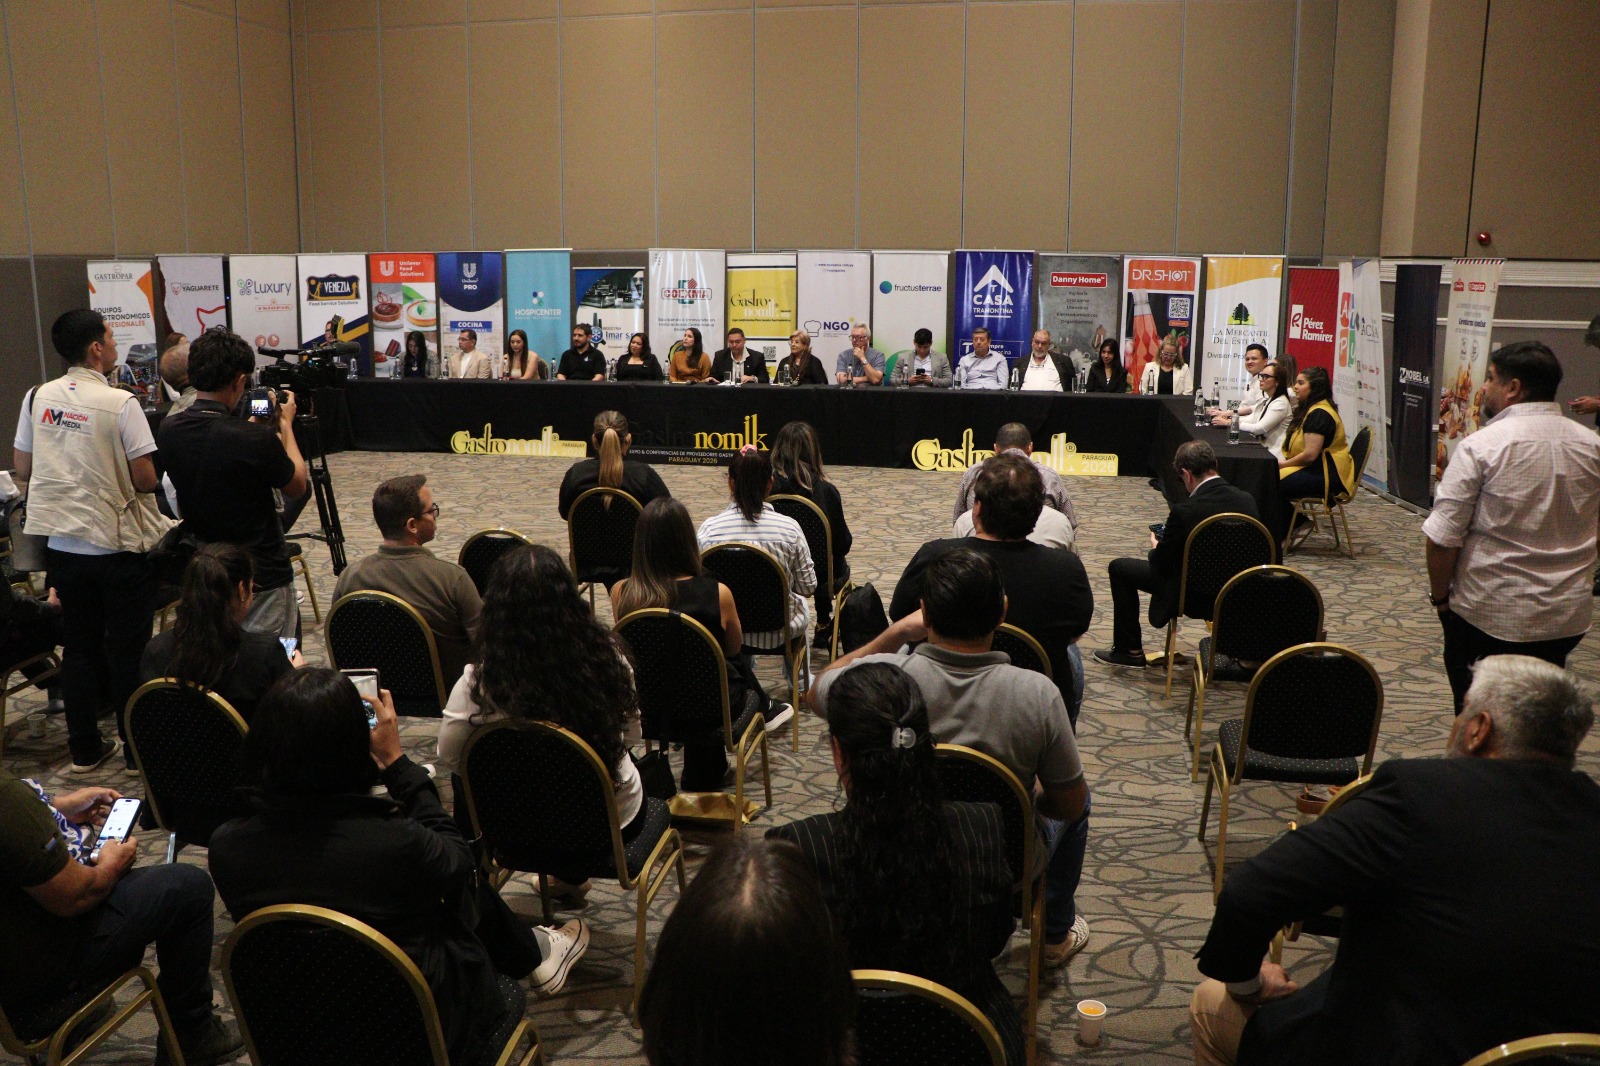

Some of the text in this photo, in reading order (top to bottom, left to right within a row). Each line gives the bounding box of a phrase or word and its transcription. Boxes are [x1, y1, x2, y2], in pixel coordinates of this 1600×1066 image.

[94, 272, 133, 281] GASTROPAR
[1052, 275, 1078, 285] Danny
[182, 284, 220, 292] YAGUARETE
[253, 280, 292, 296] Luxury
[323, 281, 351, 293] VENEZIA
[894, 284, 942, 292] fructusterrae
[730, 289, 768, 307] Gastro
[972, 294, 1014, 306] CASA
[103, 312, 151, 321] STRONOMICOS
[514, 308, 562, 316] HOSPICENTER
[107, 319, 145, 328] FESIONALES
[823, 321, 850, 331] NGO
[1303, 317, 1324, 330] Pérez
[605, 331, 624, 339] Imar
[1302, 329, 1334, 343] Ramírez
[1360, 324, 1380, 338] ACSA
[63, 411, 89, 422] NACIÓN
[61, 420, 82, 430] MEDIA
[1081, 461, 1116, 473] 2026
